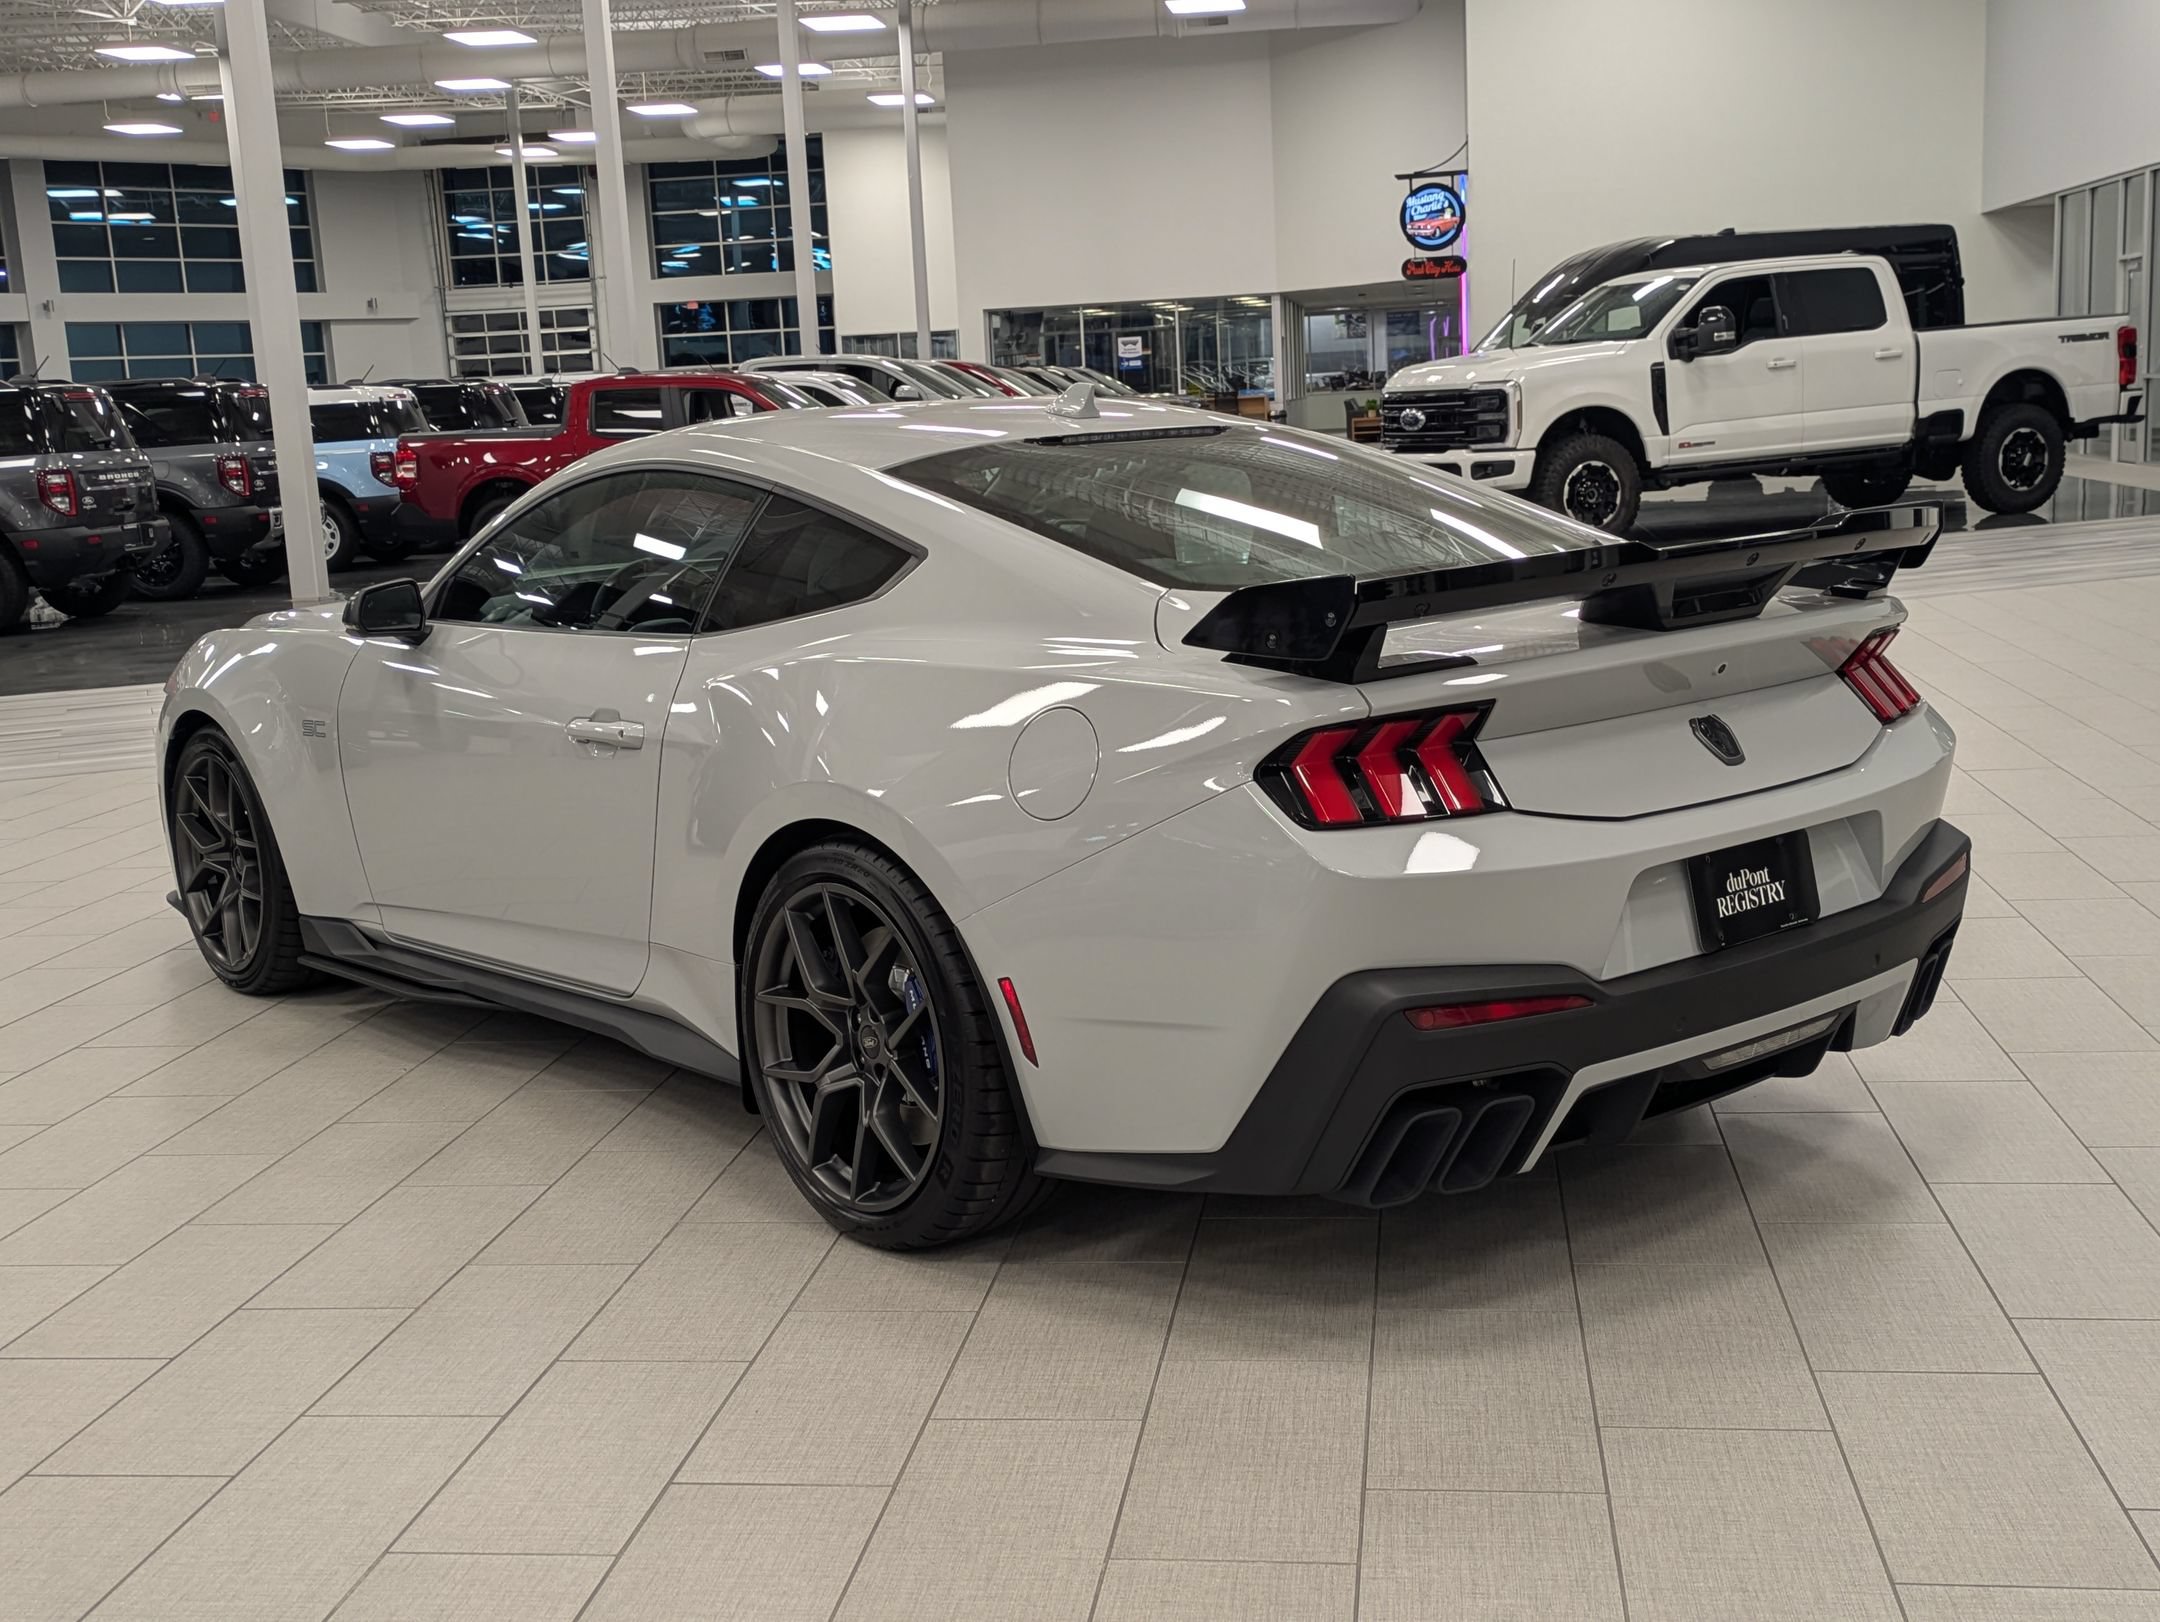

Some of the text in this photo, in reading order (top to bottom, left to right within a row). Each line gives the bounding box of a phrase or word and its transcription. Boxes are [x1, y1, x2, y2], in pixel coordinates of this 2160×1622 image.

[1406, 191, 1446, 208] Mustang
[1411, 199, 1449, 216] Charlie's
[2058, 331, 2110, 344] TREMOR
[98, 472, 140, 481] BRONCO
[1726, 866, 1770, 893] duPont
[1716, 880, 1786, 918] REGISTRY
